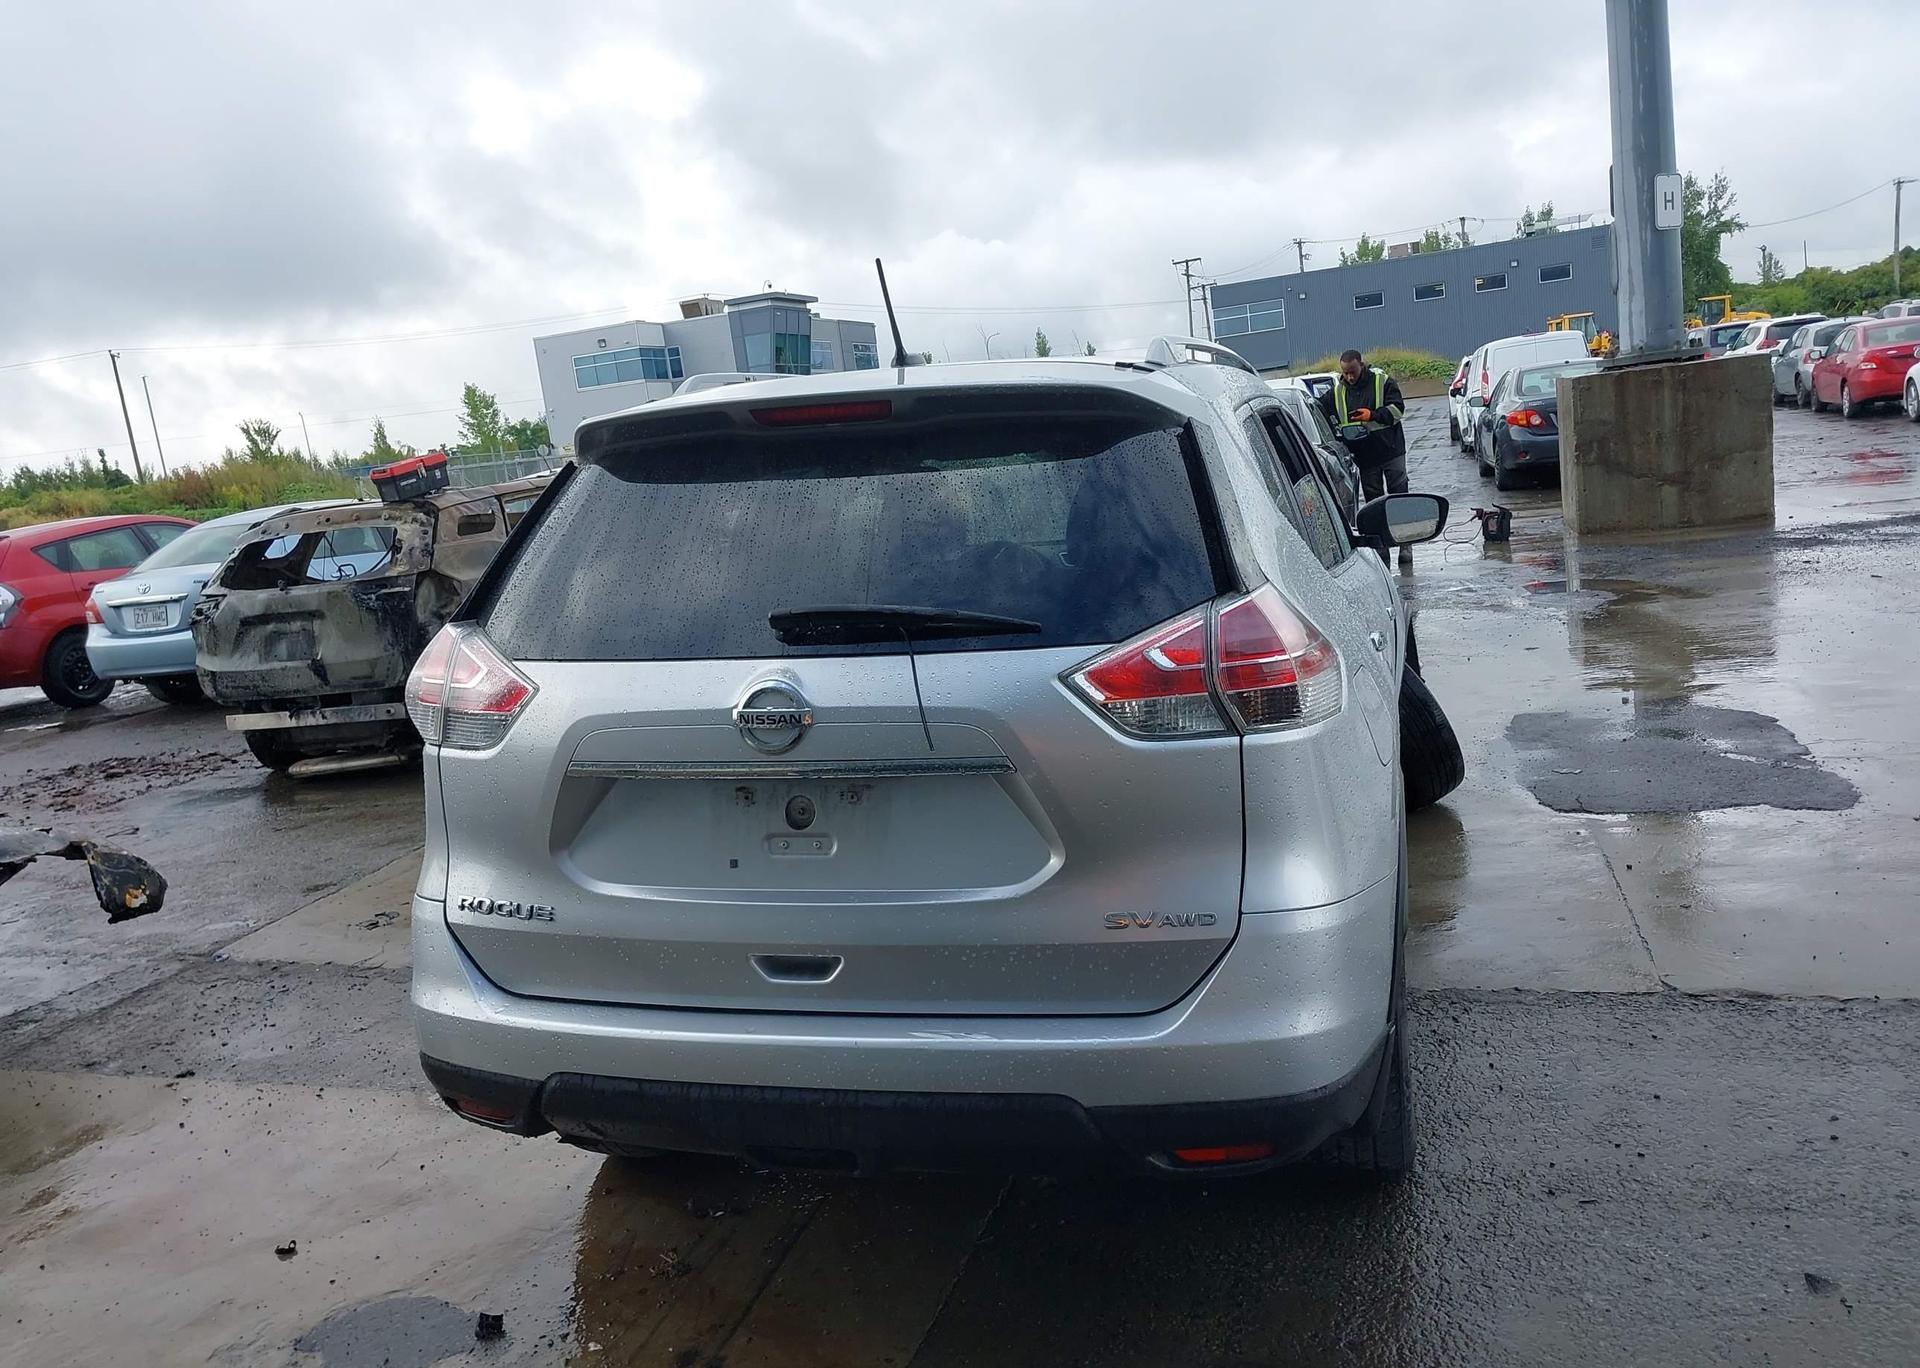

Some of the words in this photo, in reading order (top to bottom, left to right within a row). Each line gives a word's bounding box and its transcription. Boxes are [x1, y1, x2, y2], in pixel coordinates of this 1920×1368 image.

[1664, 191, 1675, 211] H
[738, 713, 803, 726] NISSAN
[457, 896, 555, 921] ROGUE
[1104, 911, 1152, 929] SV
[1158, 911, 1218, 928] AWD
